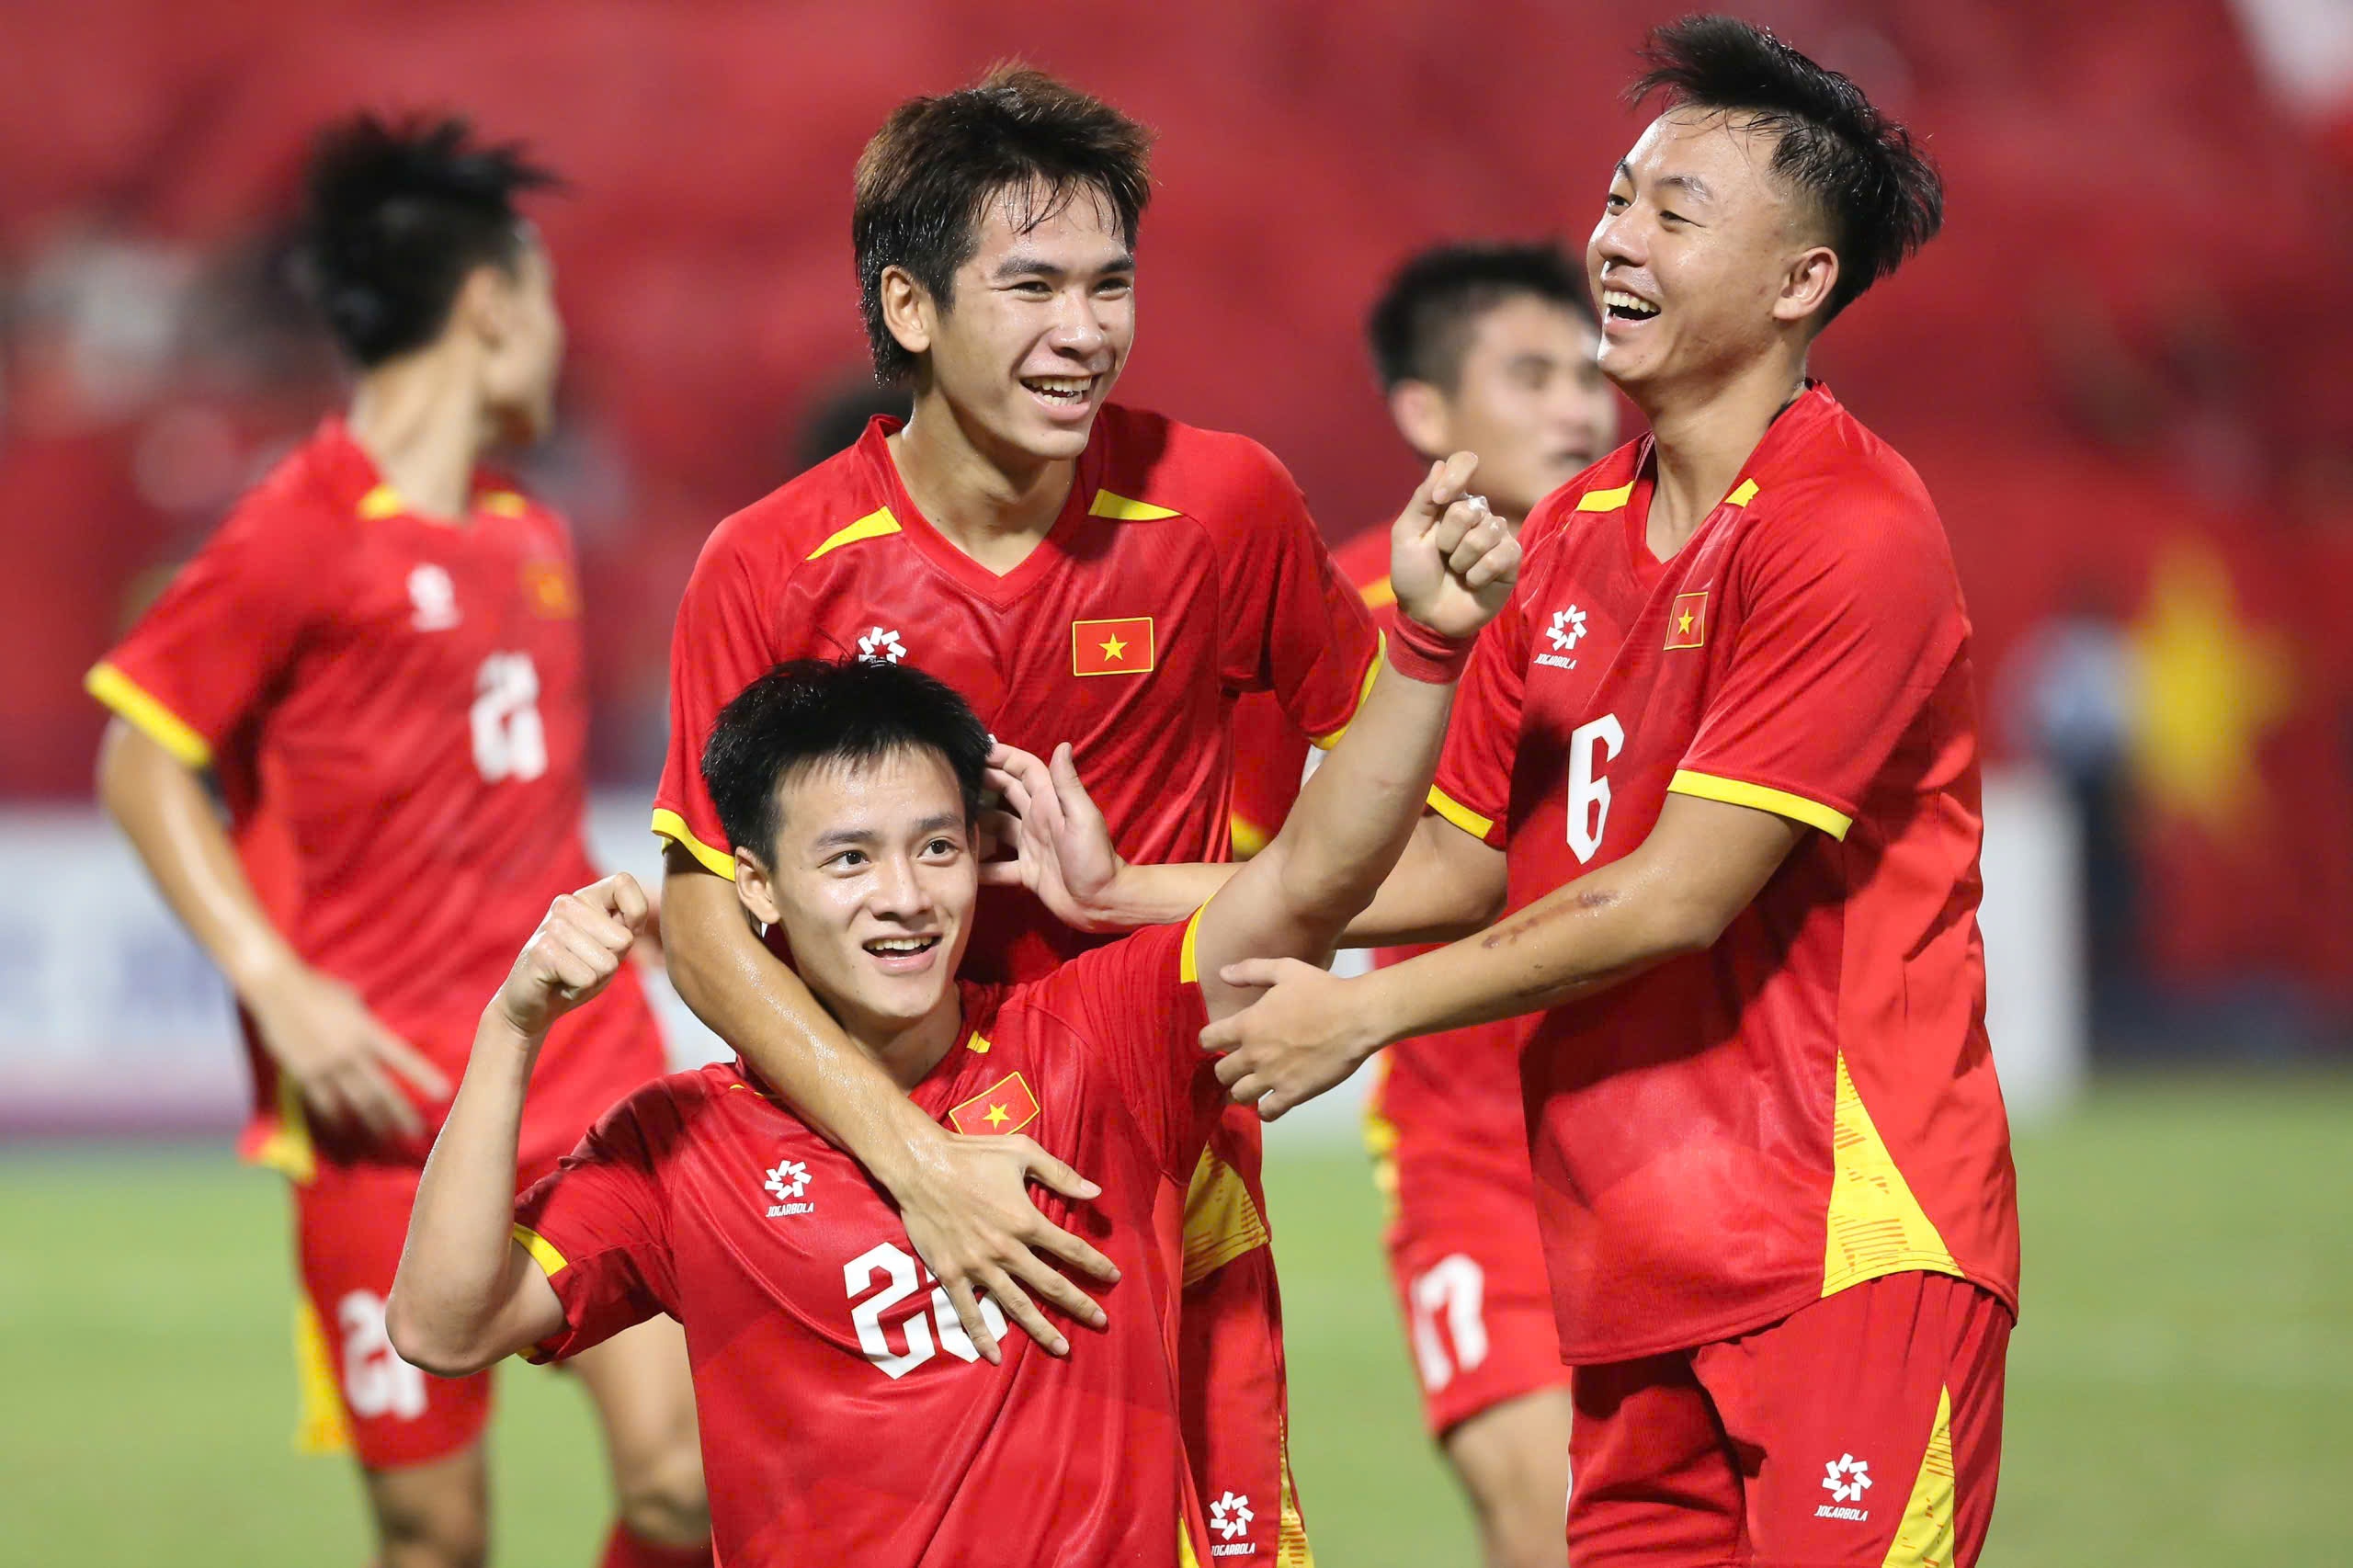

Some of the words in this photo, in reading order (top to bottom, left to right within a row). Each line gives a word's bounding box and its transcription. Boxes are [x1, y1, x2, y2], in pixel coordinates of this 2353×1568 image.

[1566, 712, 1625, 865] 6
[765, 1201, 814, 1218] JOGARBOLA
[1410, 1253, 1490, 1394] 17
[1813, 1505, 1869, 1522] JOGARBOLA
